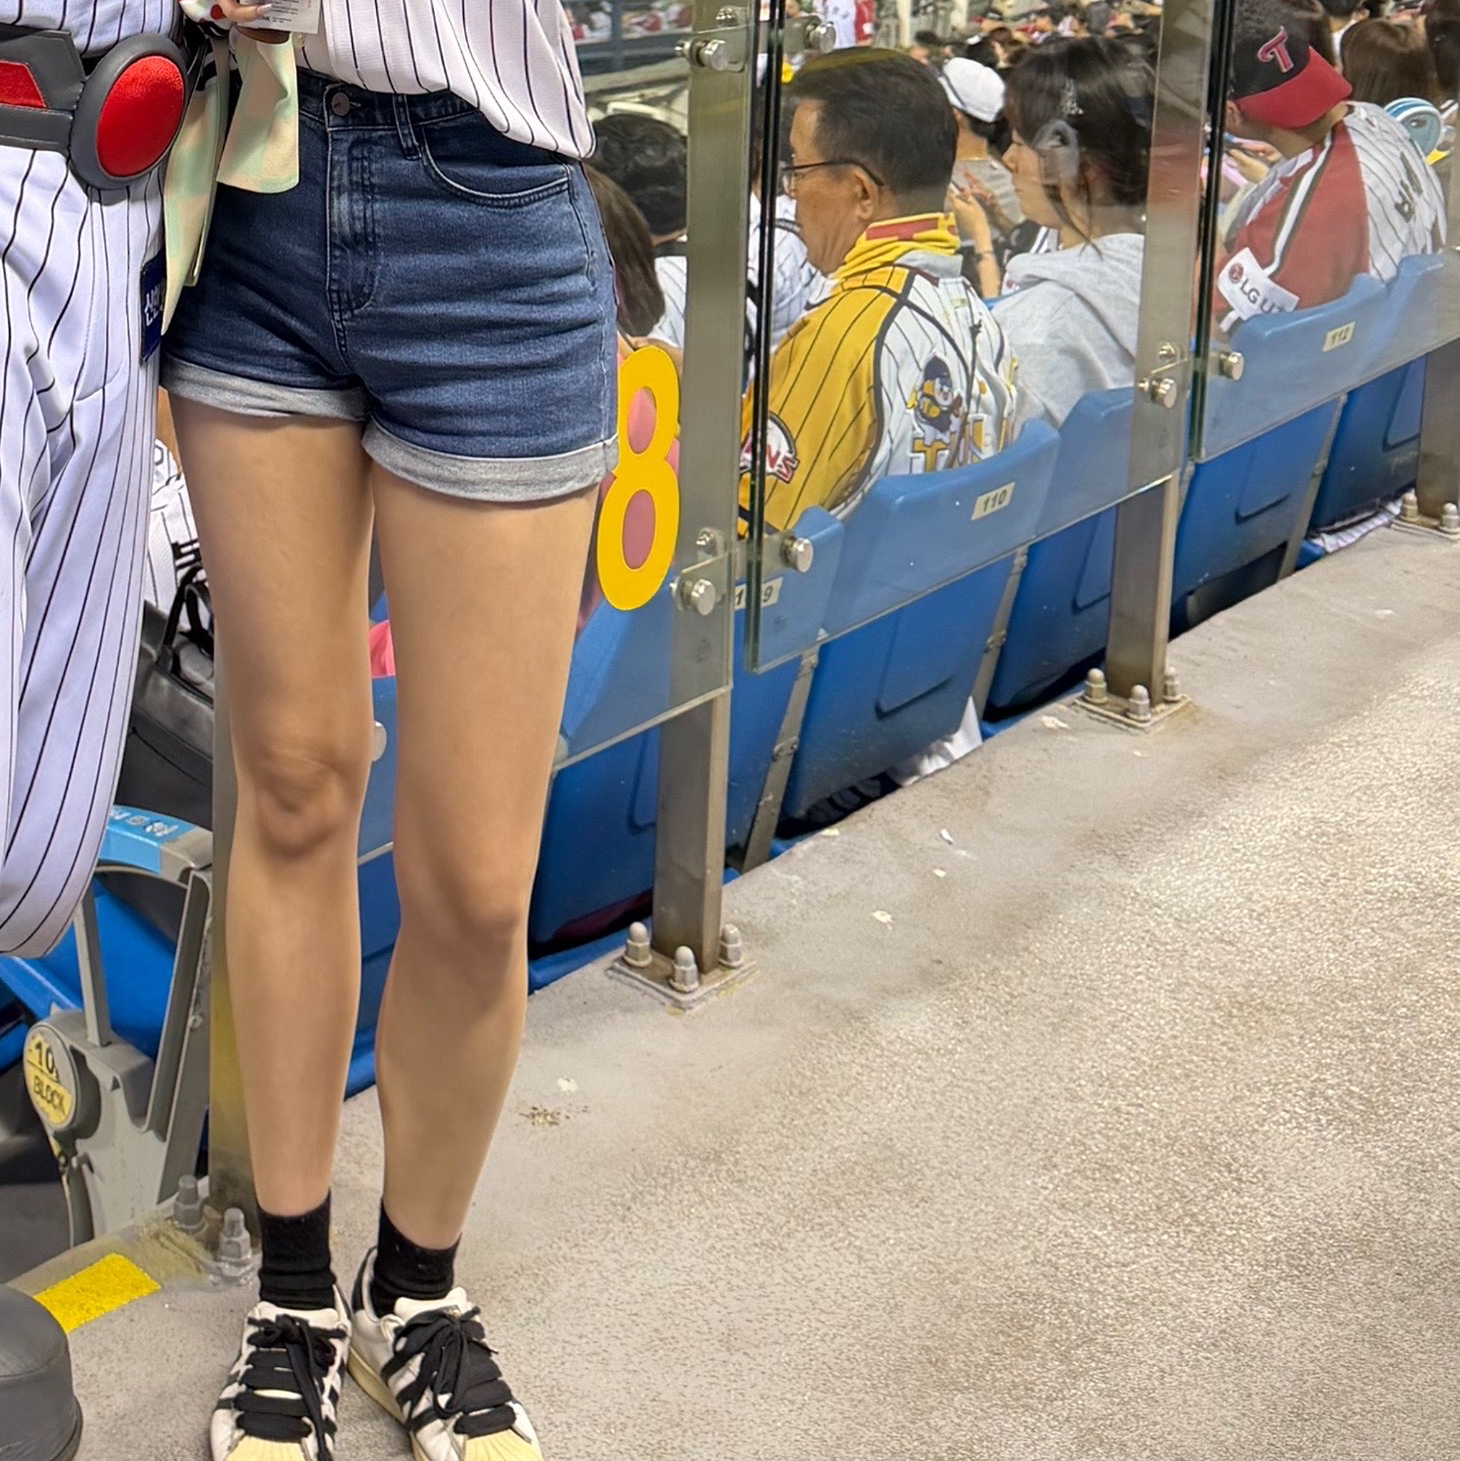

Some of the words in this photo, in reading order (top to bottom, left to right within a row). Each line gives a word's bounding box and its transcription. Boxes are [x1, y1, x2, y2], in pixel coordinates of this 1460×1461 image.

[1257, 25, 1294, 73] T
[1239, 277, 1260, 304] LG
[596, 346, 680, 611] 8
[981, 488, 1008, 511] 110
[734, 584, 774, 607] 19
[33, 1075, 67, 1116] BLOCK
